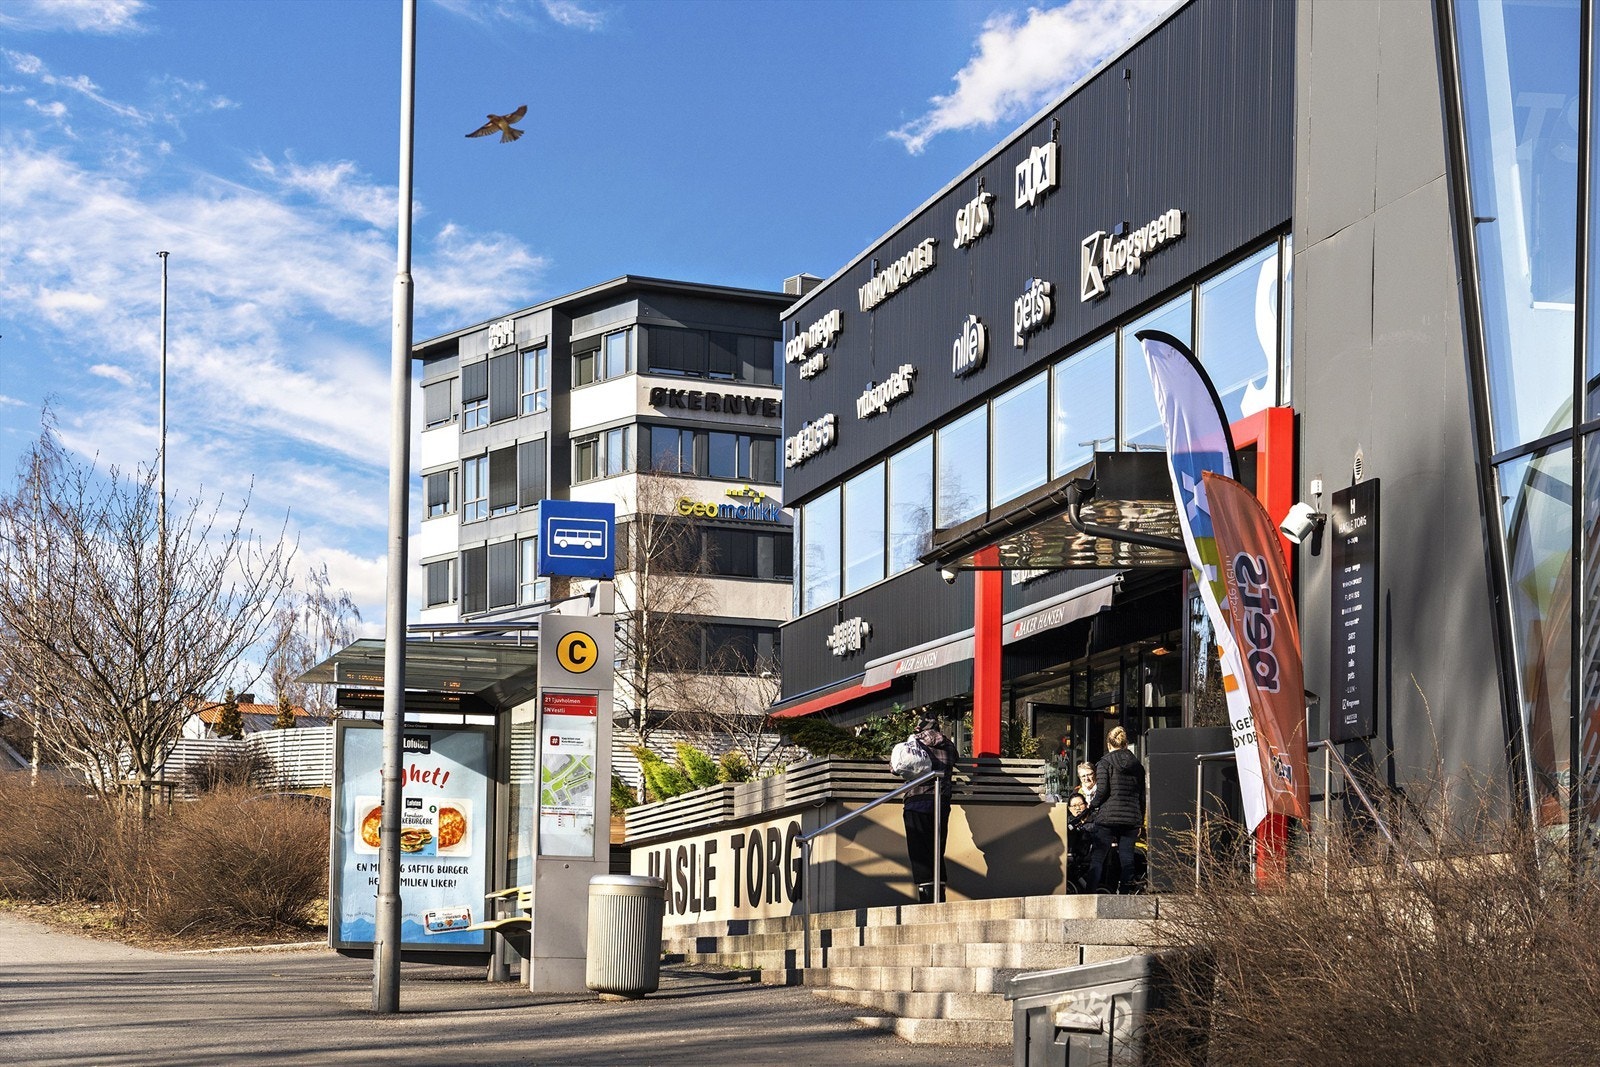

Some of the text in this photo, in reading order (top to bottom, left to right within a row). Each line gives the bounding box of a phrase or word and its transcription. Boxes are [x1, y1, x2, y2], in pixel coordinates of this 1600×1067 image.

[1017, 151, 1050, 201] MIX
[953, 191, 989, 249] SATS
[1103, 208, 1182, 275] Krogsveen
[858, 237, 935, 312] VINMONOPOLET
[785, 309, 840, 364] coop mega
[1014, 278, 1050, 347] pets
[952, 316, 982, 373] nille
[649, 386, 782, 419] ØKERNVE
[677, 496, 781, 522] Geomatikk
[1037, 606, 1066, 631] HANSEN
[568, 639, 588, 665] C
[356, 862, 367, 872] EN
[408, 864, 435, 875] SAFTIG
[437, 865, 469, 875] BURGER
[431, 879, 457, 889] LIKER!
[730, 820, 803, 909] TORG
